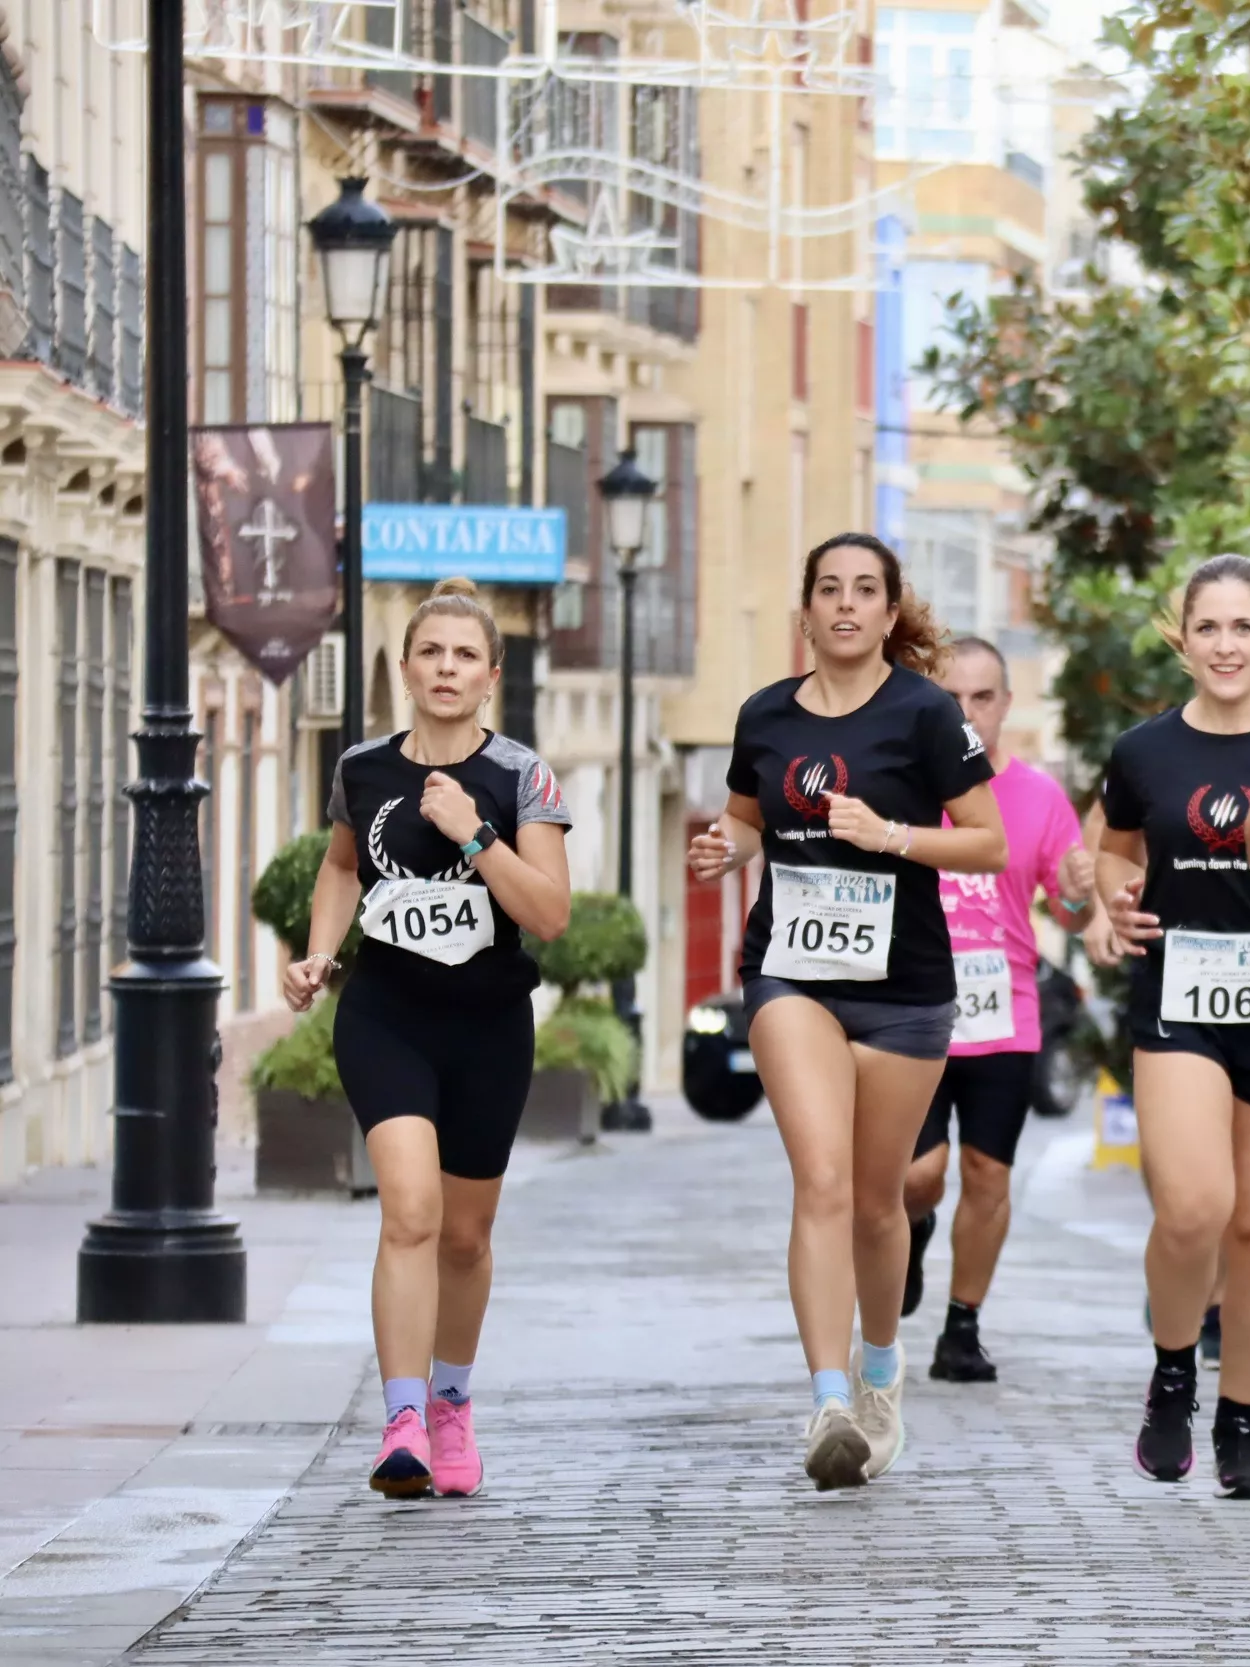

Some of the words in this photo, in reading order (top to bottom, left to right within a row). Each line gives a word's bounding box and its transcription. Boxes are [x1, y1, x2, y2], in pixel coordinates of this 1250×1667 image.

[361, 517, 558, 553] CONTAFISA
[806, 828, 827, 838] down
[1173, 857, 1207, 871] Running
[1208, 858, 1232, 870] down
[1233, 859, 1248, 871] the
[382, 899, 479, 944] 1054
[787, 916, 876, 956] 1055
